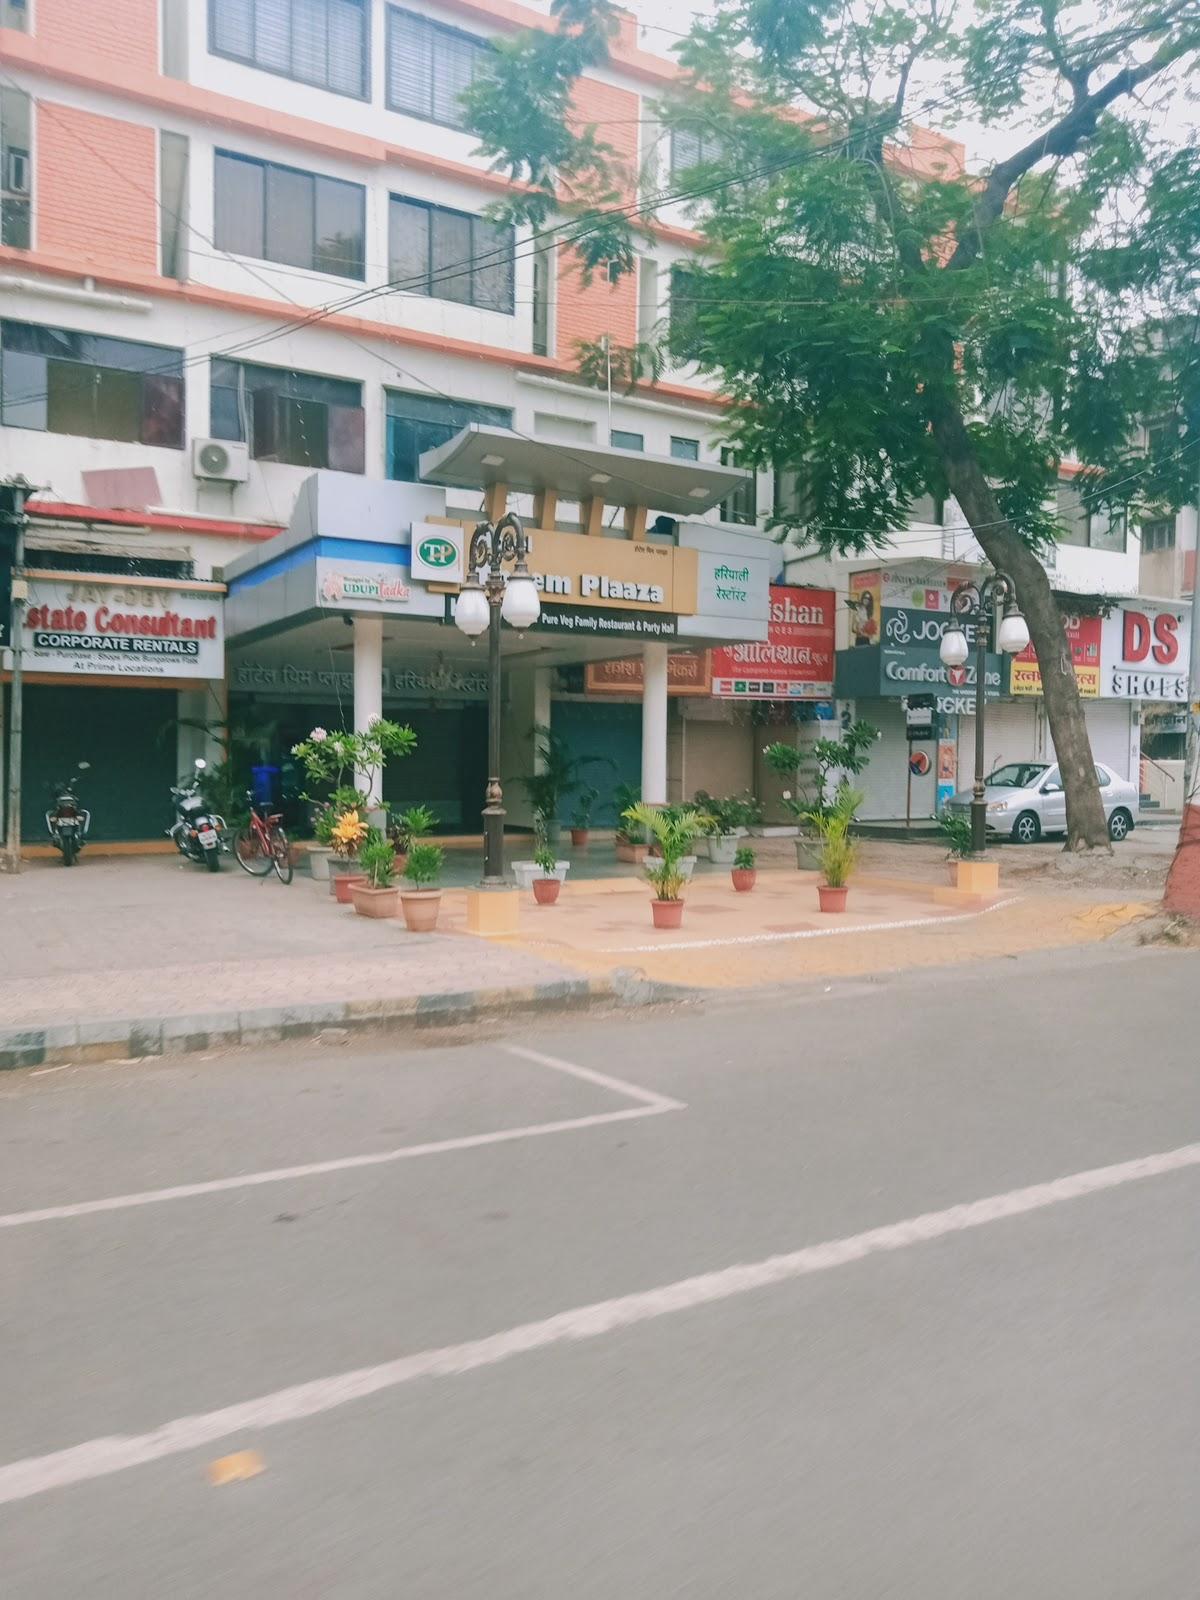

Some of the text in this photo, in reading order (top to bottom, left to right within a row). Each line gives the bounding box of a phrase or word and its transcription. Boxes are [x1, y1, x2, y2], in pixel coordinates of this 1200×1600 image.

[424, 543, 453, 564] TP
[714, 564, 750, 582] हरियाली
[343, 583, 379, 595] UDUPI
[581, 573, 664, 603] Plaaza
[23, 604, 87, 632] state
[94, 606, 217, 639] Consultant
[768, 594, 824, 625] ishan
[542, 612, 675, 635] Pure Veg Family Restaurant & Party Hall
[912, 620, 978, 644] JOCE
[37, 633, 198, 654] CORPORATE RENTALS
[1122, 610, 1179, 665] DS
[118, 663, 164, 673] Locations
[886, 660, 947, 684] Comfort
[1112, 673, 1185, 698] SHOES
